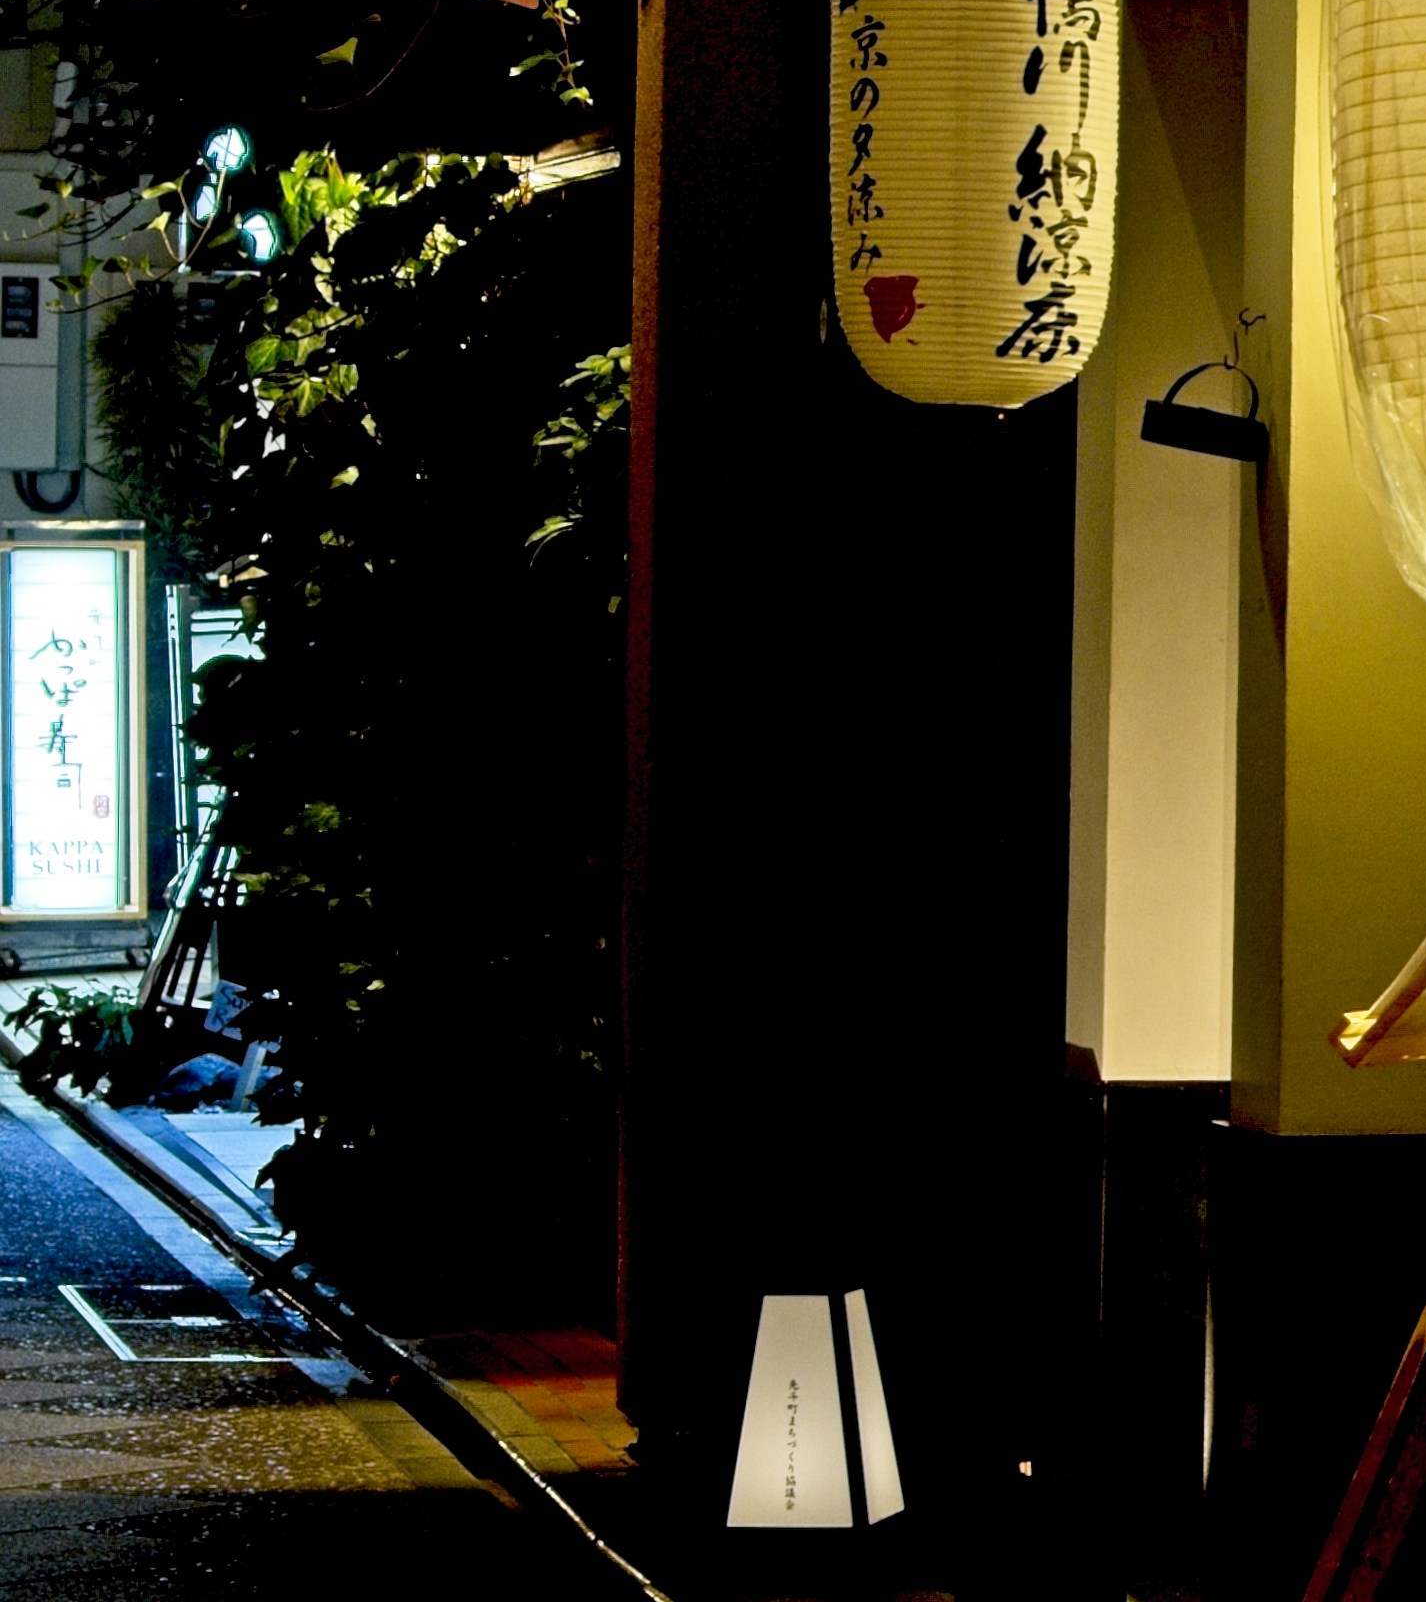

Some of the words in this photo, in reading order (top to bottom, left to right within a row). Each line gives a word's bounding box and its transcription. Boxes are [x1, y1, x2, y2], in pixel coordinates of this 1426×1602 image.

[847, 14, 888, 274] 京の夕涼み
[28, 628, 88, 810] かっぱ寿司
[29, 840, 104, 857] KAPPA
[32, 859, 102, 875] SUSHI
